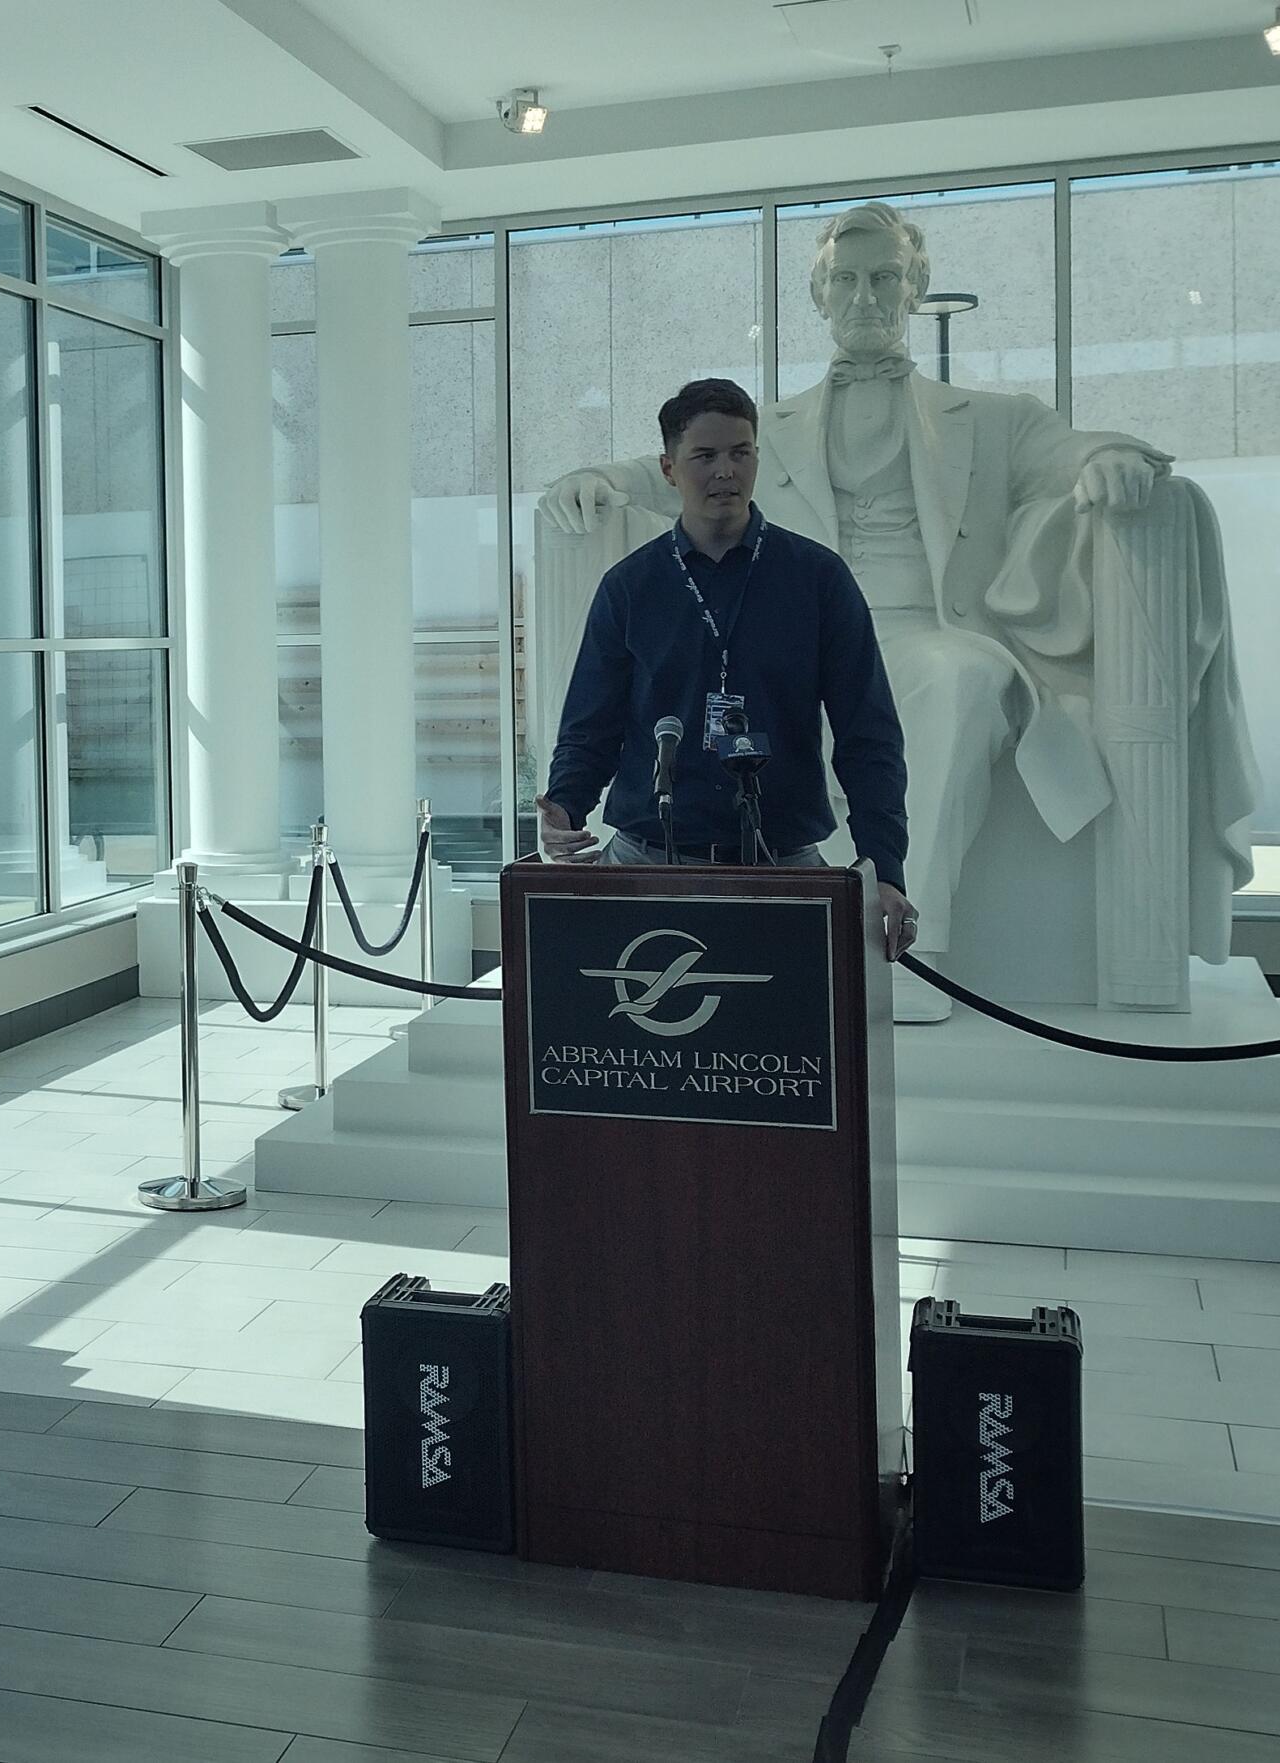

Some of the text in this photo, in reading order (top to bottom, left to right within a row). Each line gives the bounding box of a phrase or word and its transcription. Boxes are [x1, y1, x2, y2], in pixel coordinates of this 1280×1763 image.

[541, 1045, 821, 1074] ABRAHAM LINCOLN
[541, 1067, 822, 1098] CAPITAL AIRPORT
[419, 1364, 451, 1488] RAMSA
[978, 1392, 1014, 1523] RAMSA
